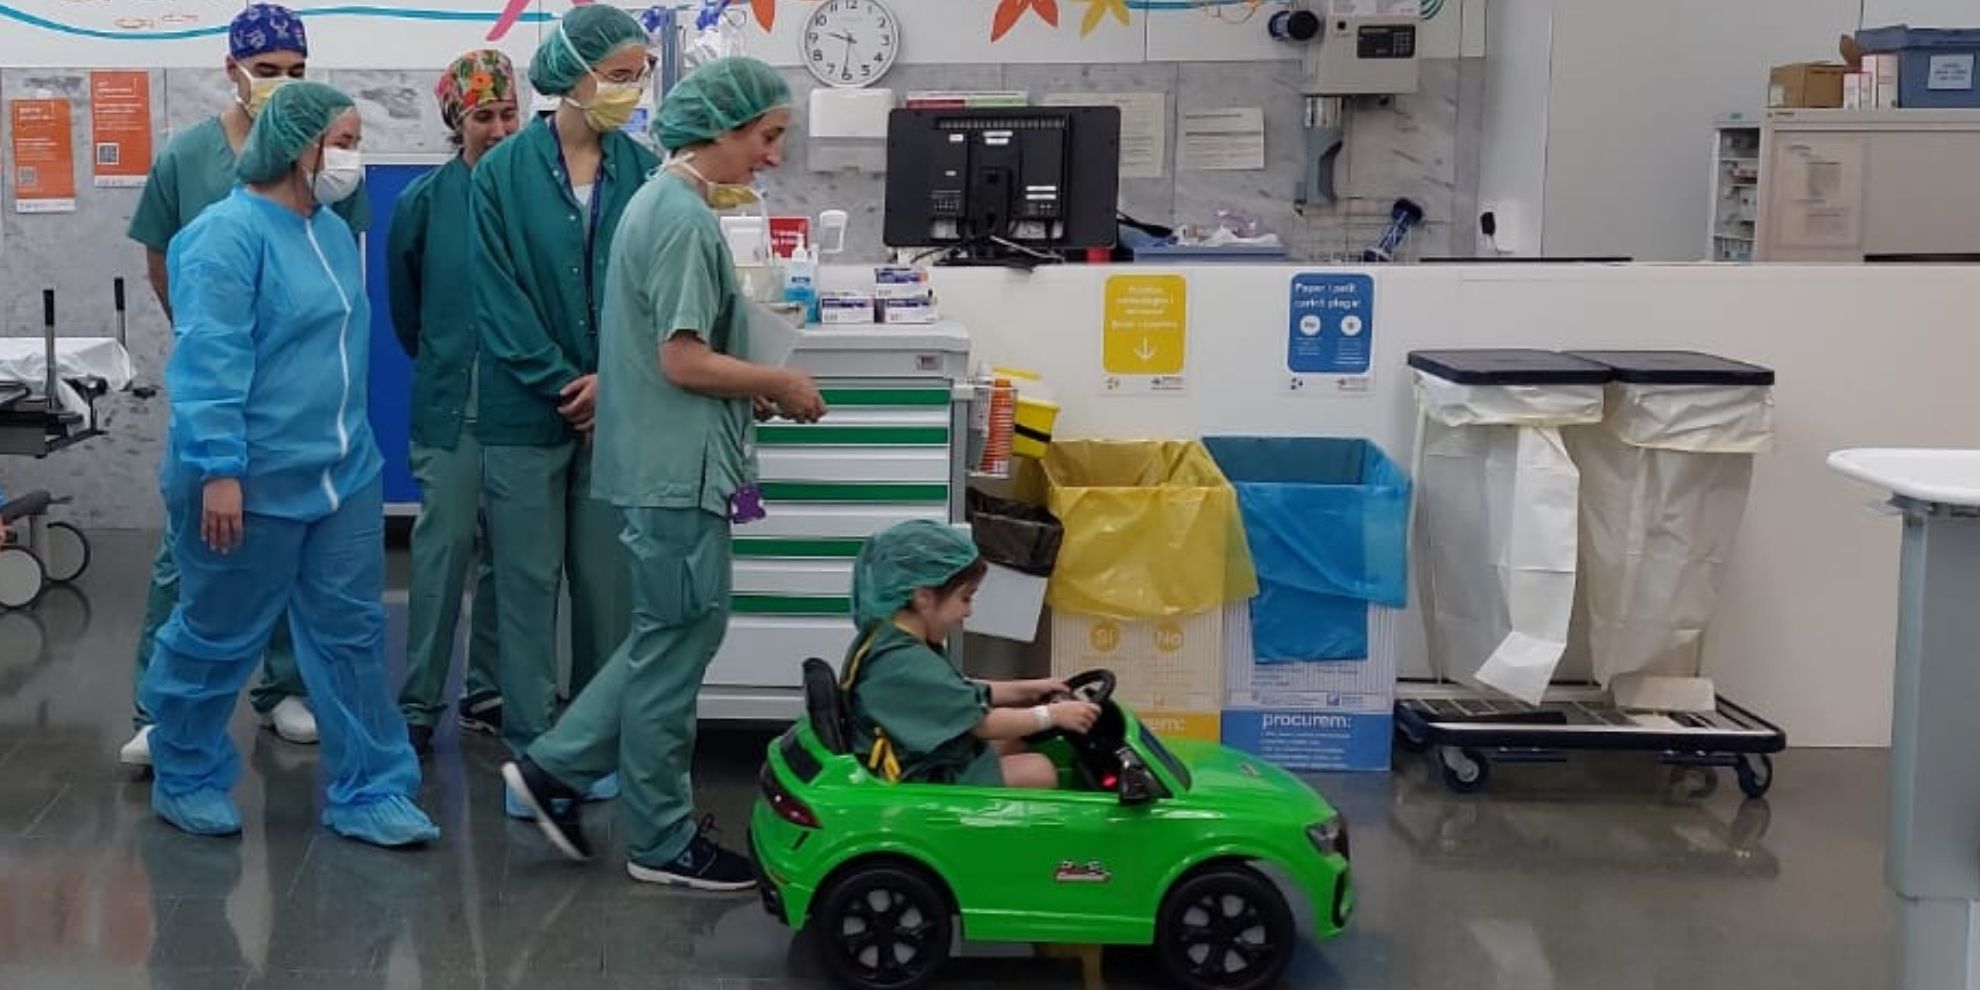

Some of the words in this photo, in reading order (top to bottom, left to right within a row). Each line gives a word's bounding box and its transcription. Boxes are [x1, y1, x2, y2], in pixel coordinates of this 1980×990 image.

[815, 14, 827, 26] 10
[878, 16, 886, 28] 2
[808, 32, 818, 44] 9
[881, 34, 890, 46] 3
[813, 49, 823, 61] 8
[873, 51, 884, 62] 4
[826, 63, 836, 74] 7
[861, 64, 870, 76] 5
[1156, 631, 1182, 646] No
[1262, 713, 1352, 730] procurem:
